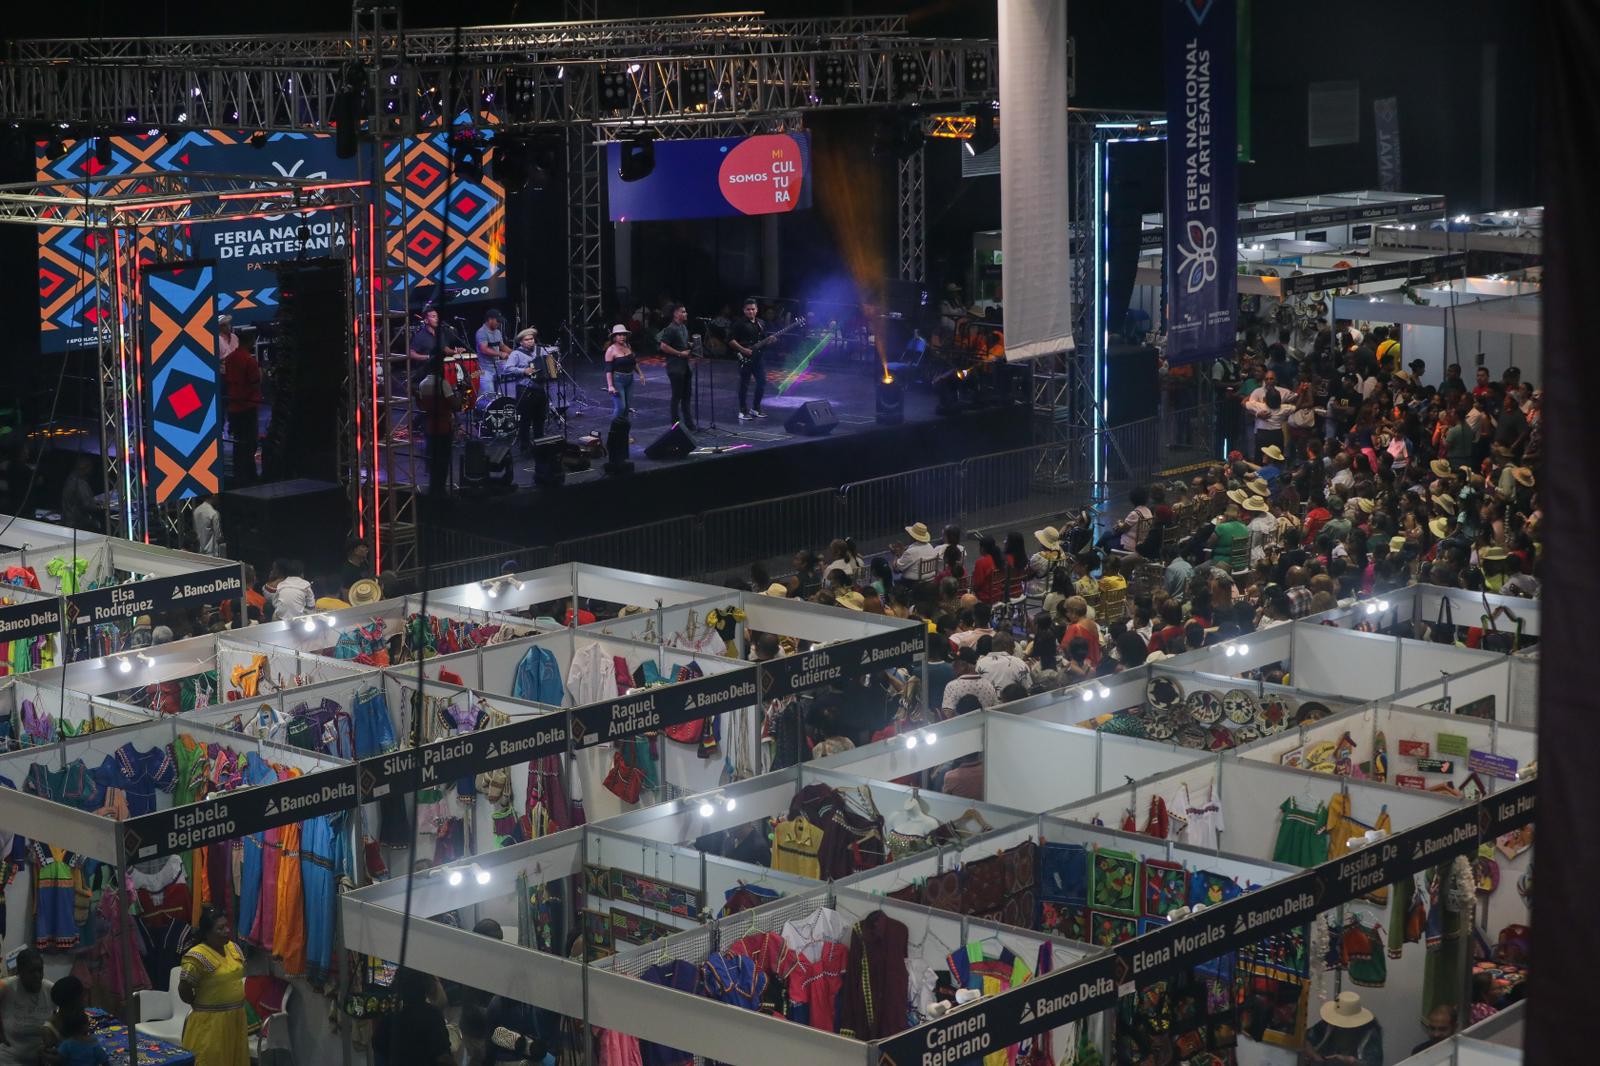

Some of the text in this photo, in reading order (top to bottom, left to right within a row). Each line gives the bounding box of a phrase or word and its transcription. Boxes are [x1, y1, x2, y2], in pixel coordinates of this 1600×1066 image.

[1186, 38, 1198, 212] FERIA NACIONAL
[1198, 50, 1210, 210] DE ARTESANÍAS
[772, 149, 783, 159] MI
[729, 173, 768, 184] SOMOS
[772, 160, 795, 174] CUL
[772, 176, 789, 188] TU
[776, 190, 790, 202] RA
[214, 229, 266, 246] FERIA
[220, 245, 244, 259] DE
[111, 588, 135, 603] Elsa
[184, 577, 240, 598] Banco Delta
[0, 611, 58, 632] Banco Delta
[95, 599, 154, 620] Rodríguez
[802, 651, 830, 672] Edith
[872, 638, 924, 662] Banco Delta
[790, 666, 841, 688] Gutiérrez
[612, 694, 656, 720] Raquel
[697, 682, 756, 708] Banco Delta
[608, 712, 660, 736] Andrade
[424, 740, 473, 766] Palacio
[500, 728, 566, 755] Banco Delta
[422, 765, 438, 782] M.
[280, 782, 355, 812] Banco Delta
[174, 802, 228, 830] Isabela
[1498, 803, 1515, 822] Ilsa
[168, 819, 236, 849] Bejerano
[1424, 822, 1478, 856] Banco Delta
[1338, 844, 1398, 880] Jessika De
[1351, 868, 1384, 893] Flores
[1248, 894, 1314, 930] Banco Delta
[1133, 924, 1226, 974] Elena Morales
[1036, 978, 1114, 1018] Banco Delta
[926, 1013, 986, 1048] Carmen
[922, 1032, 990, 1066] Bejerano
